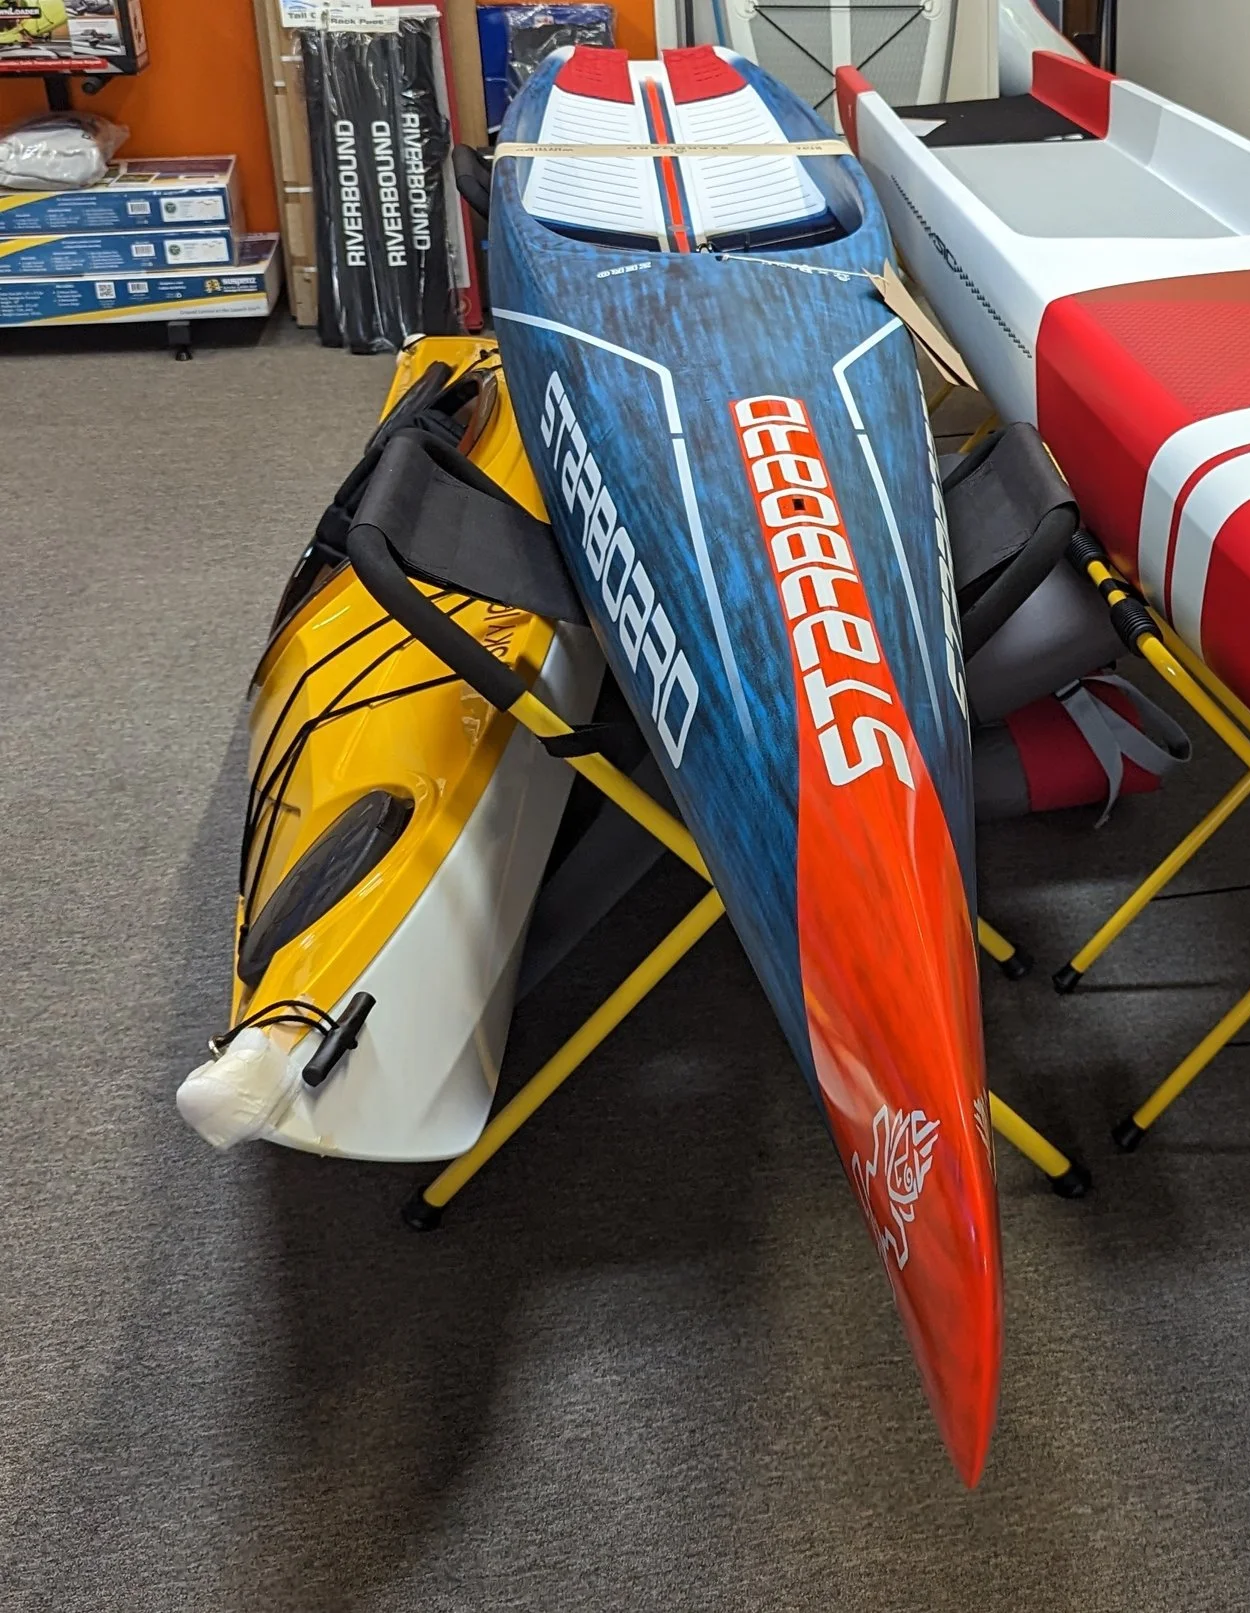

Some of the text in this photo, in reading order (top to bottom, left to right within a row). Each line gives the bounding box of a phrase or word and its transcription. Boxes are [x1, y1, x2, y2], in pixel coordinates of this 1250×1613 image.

[335, 119, 366, 267] RIVERBOUND
[371, 120, 407, 267] RIVERBOUND
[401, 112, 431, 250] RIVERBOUND
[540, 370, 699, 769] STARBOARD
[733, 394, 916, 791] STARBOARD
